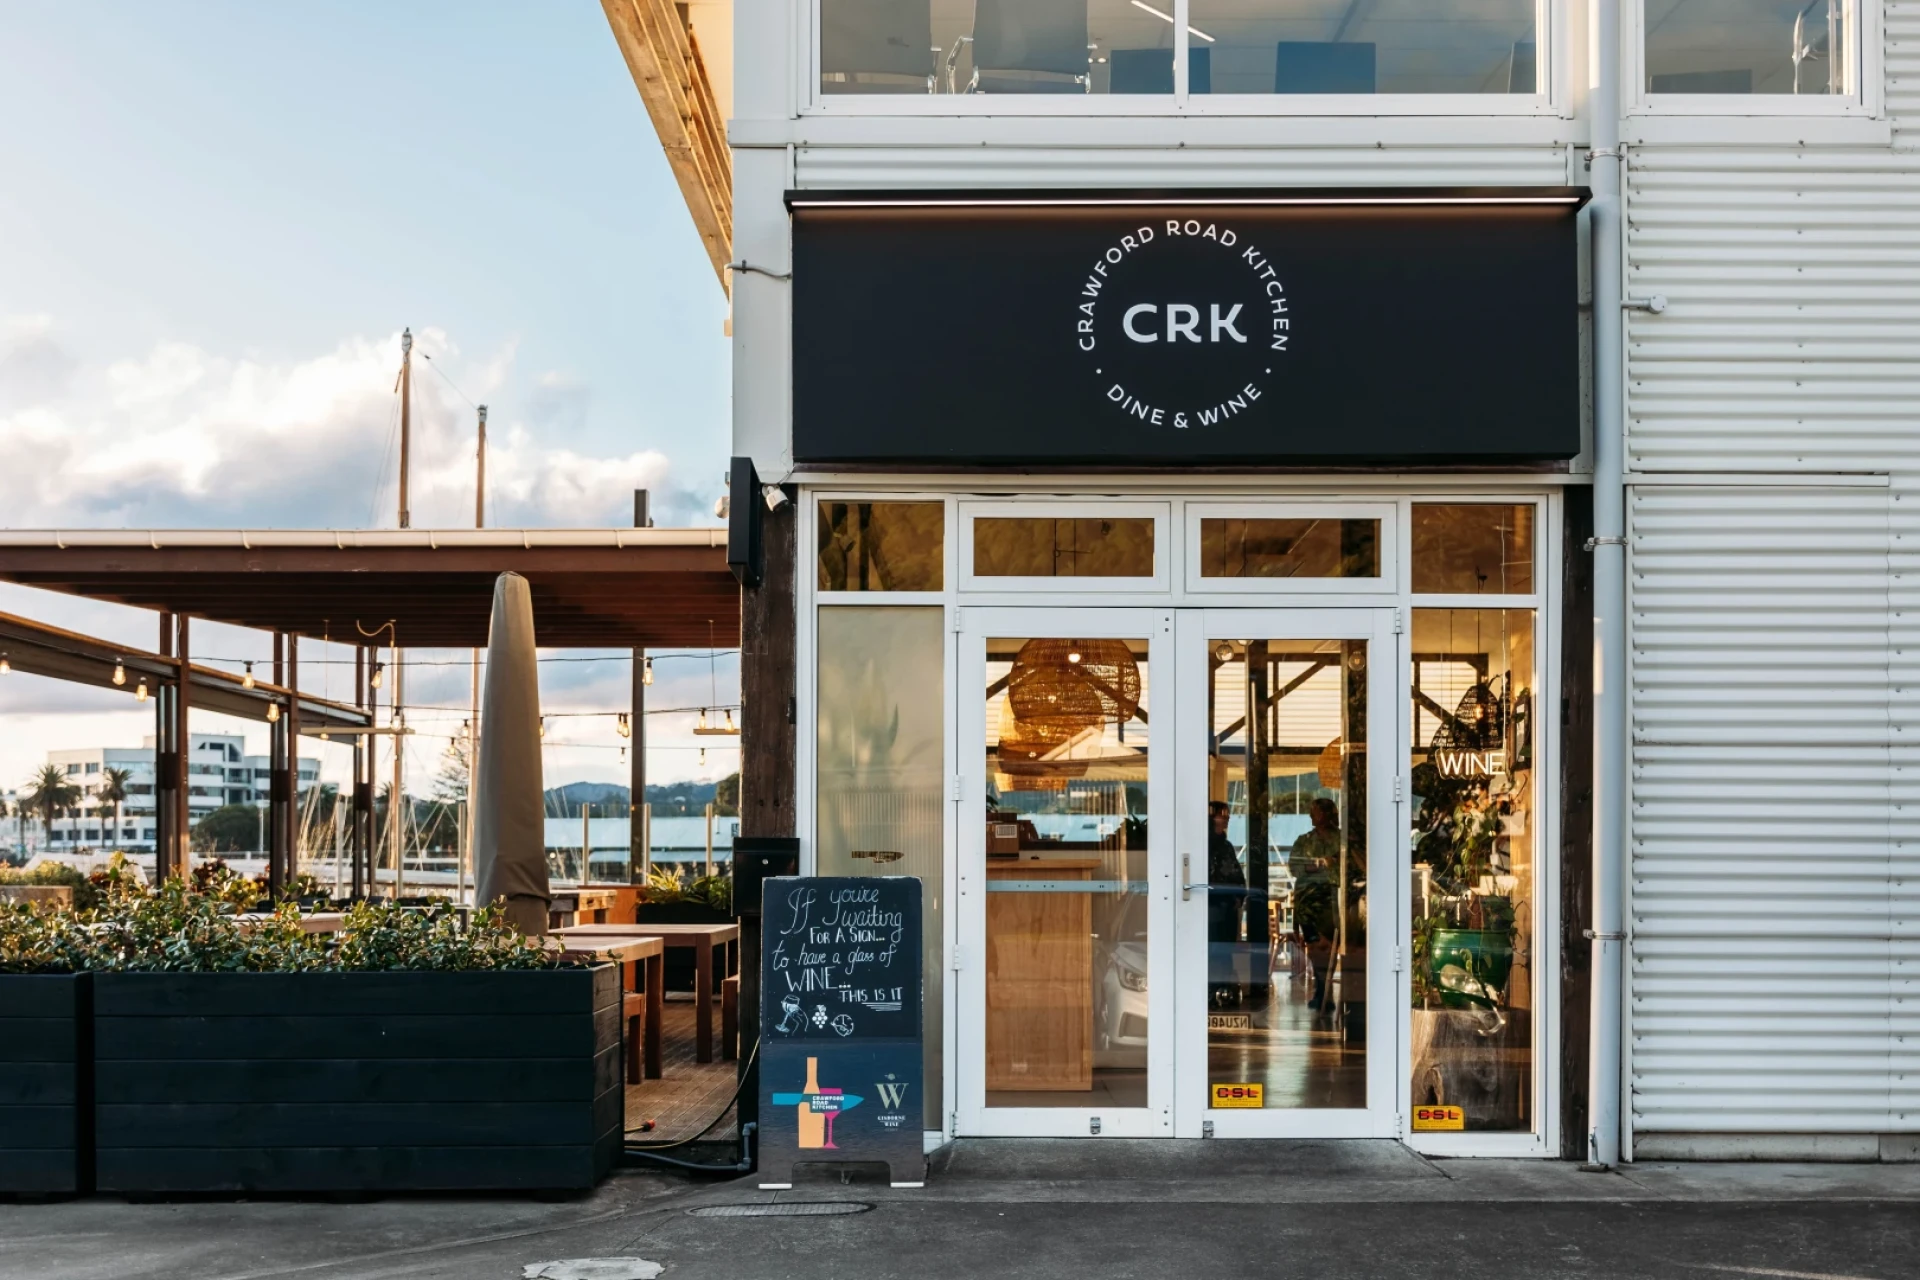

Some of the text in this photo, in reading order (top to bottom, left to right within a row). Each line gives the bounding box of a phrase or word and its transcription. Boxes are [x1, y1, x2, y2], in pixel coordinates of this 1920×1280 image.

[1078, 220, 1289, 351] CRAWFORD ROAD KITCHEN
[1122, 303, 1248, 343] CRK
[1107, 383, 1262, 428] DINE & WINE
[1440, 752, 1506, 776] WINE
[780, 887, 817, 934] If
[841, 905, 904, 943] waiting
[835, 927, 846, 943] A
[771, 940, 898, 975] to have a glass of
[839, 987, 903, 1003] THIS IS IT
[1217, 1087, 1258, 1098] CSL
[1418, 1109, 1459, 1120] CSL
